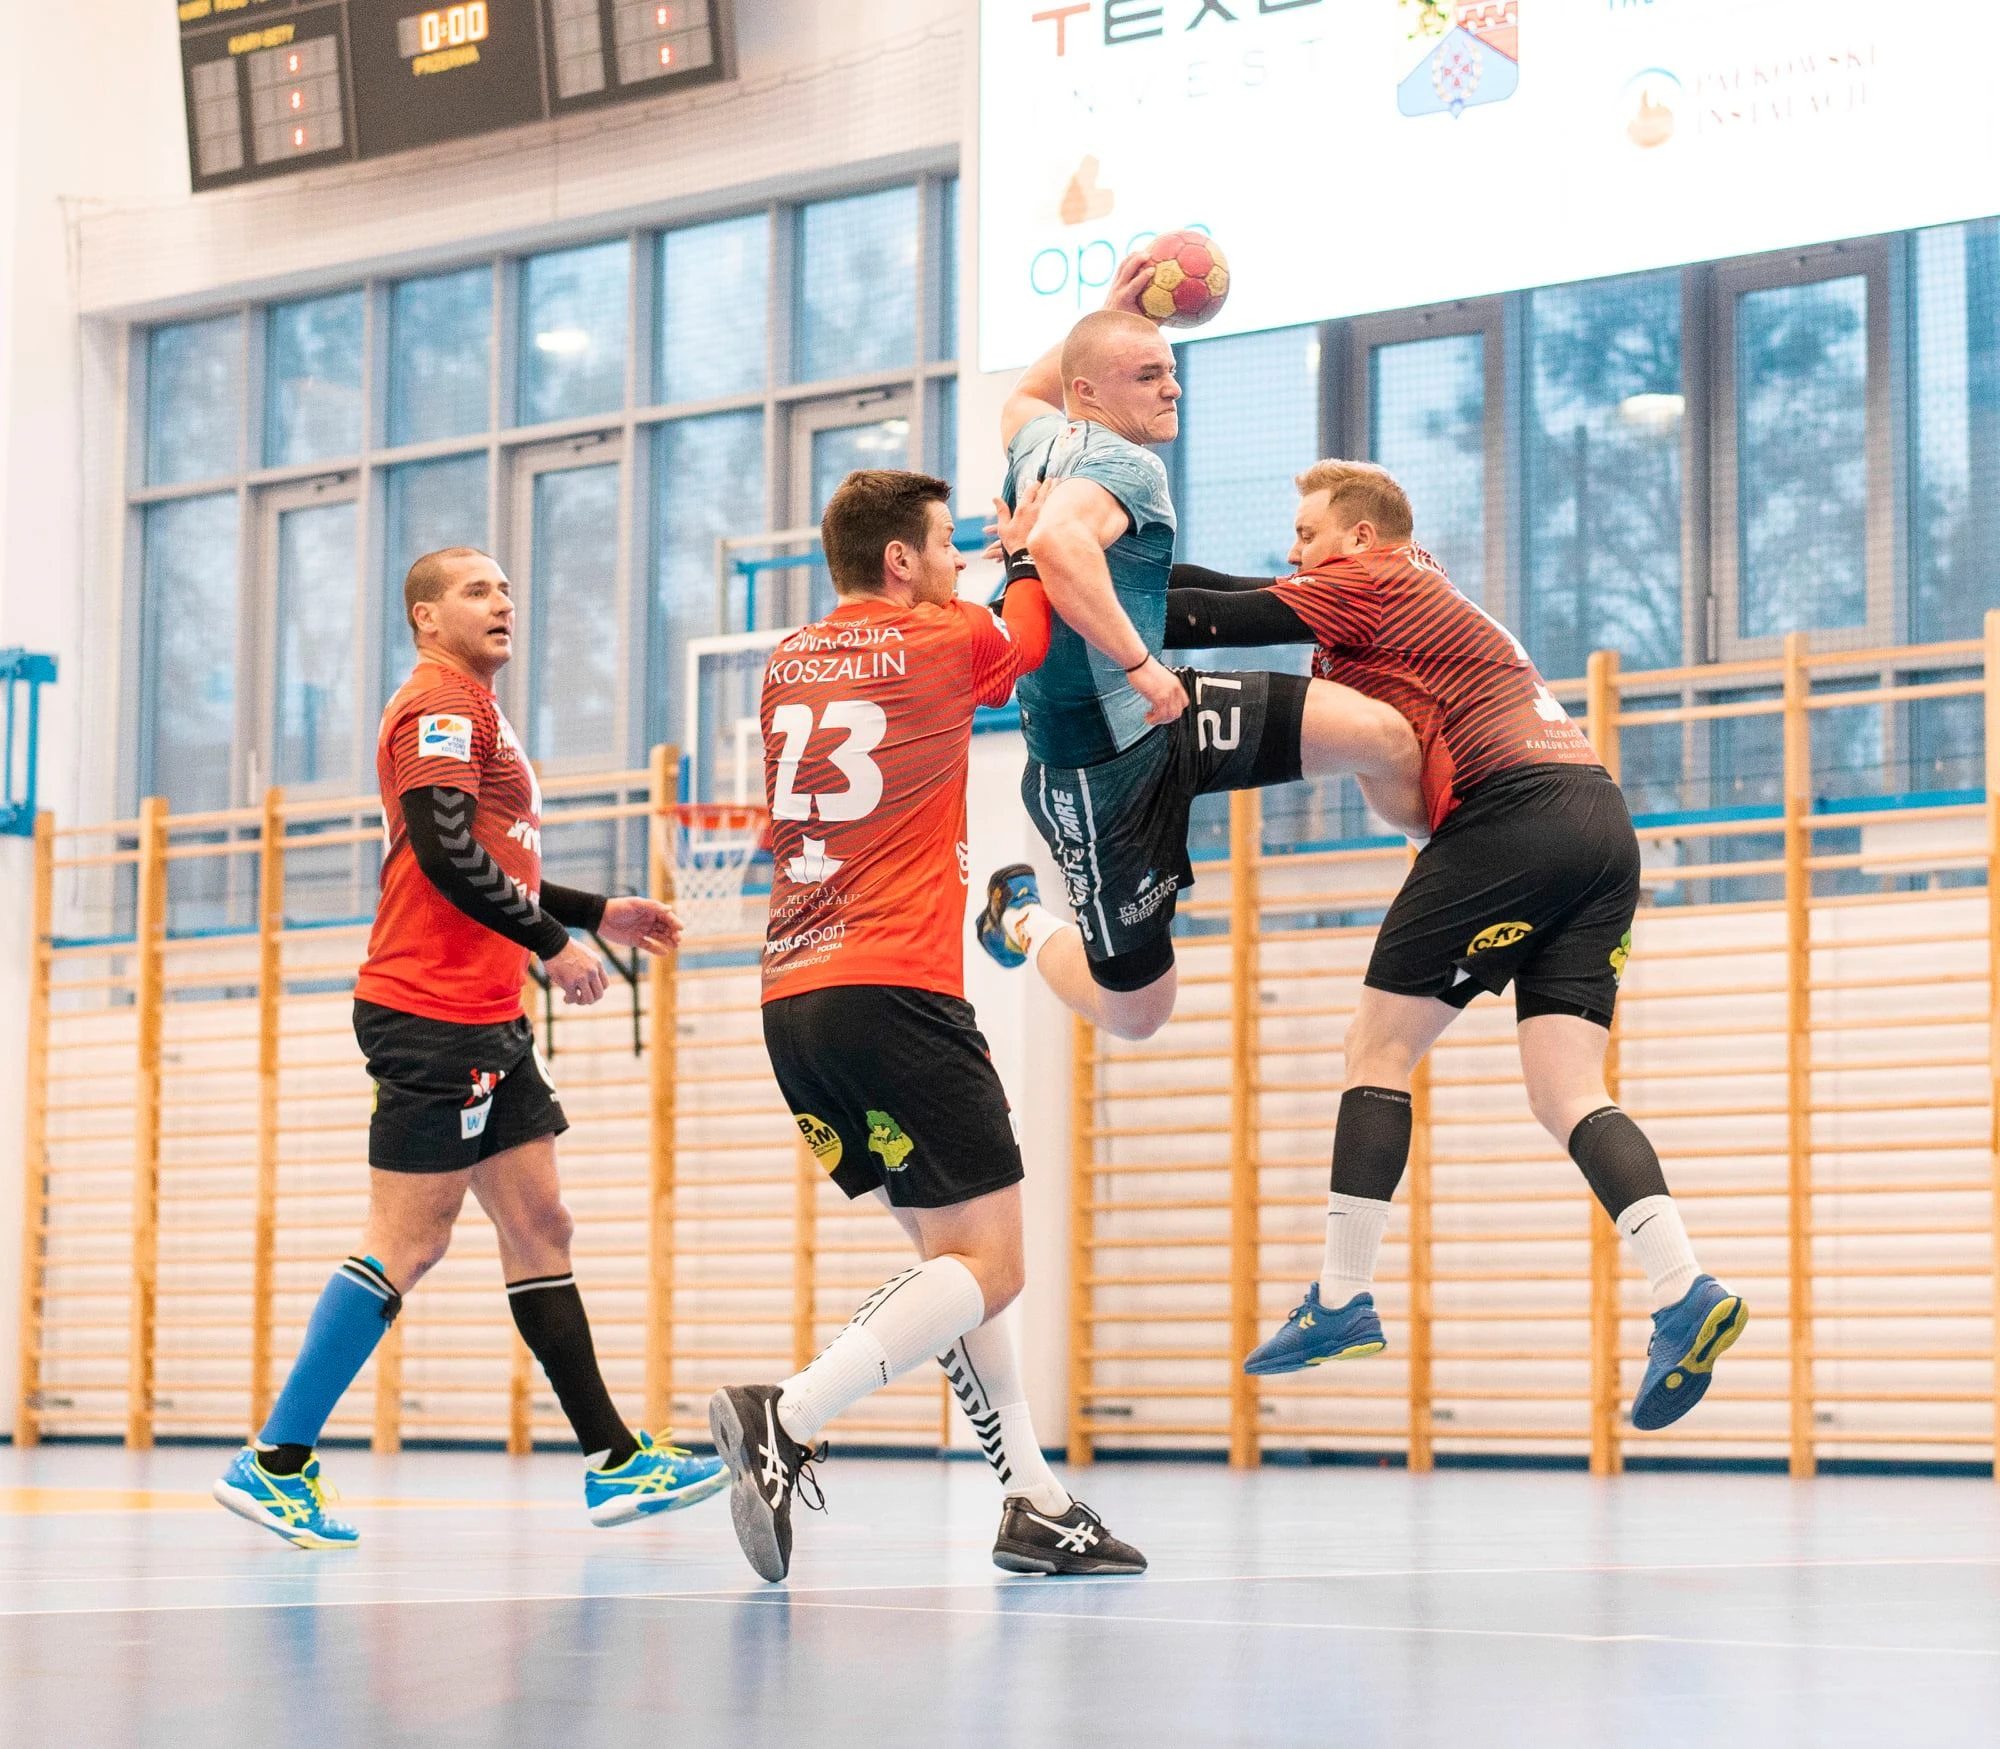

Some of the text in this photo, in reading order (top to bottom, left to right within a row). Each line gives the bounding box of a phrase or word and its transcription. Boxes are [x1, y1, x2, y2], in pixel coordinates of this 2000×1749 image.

[420, 1, 488, 51] 0:00
[768, 650, 906, 684] KOSZALIN
[771, 700, 887, 822] 13
[1118, 902, 1138, 919] KS
